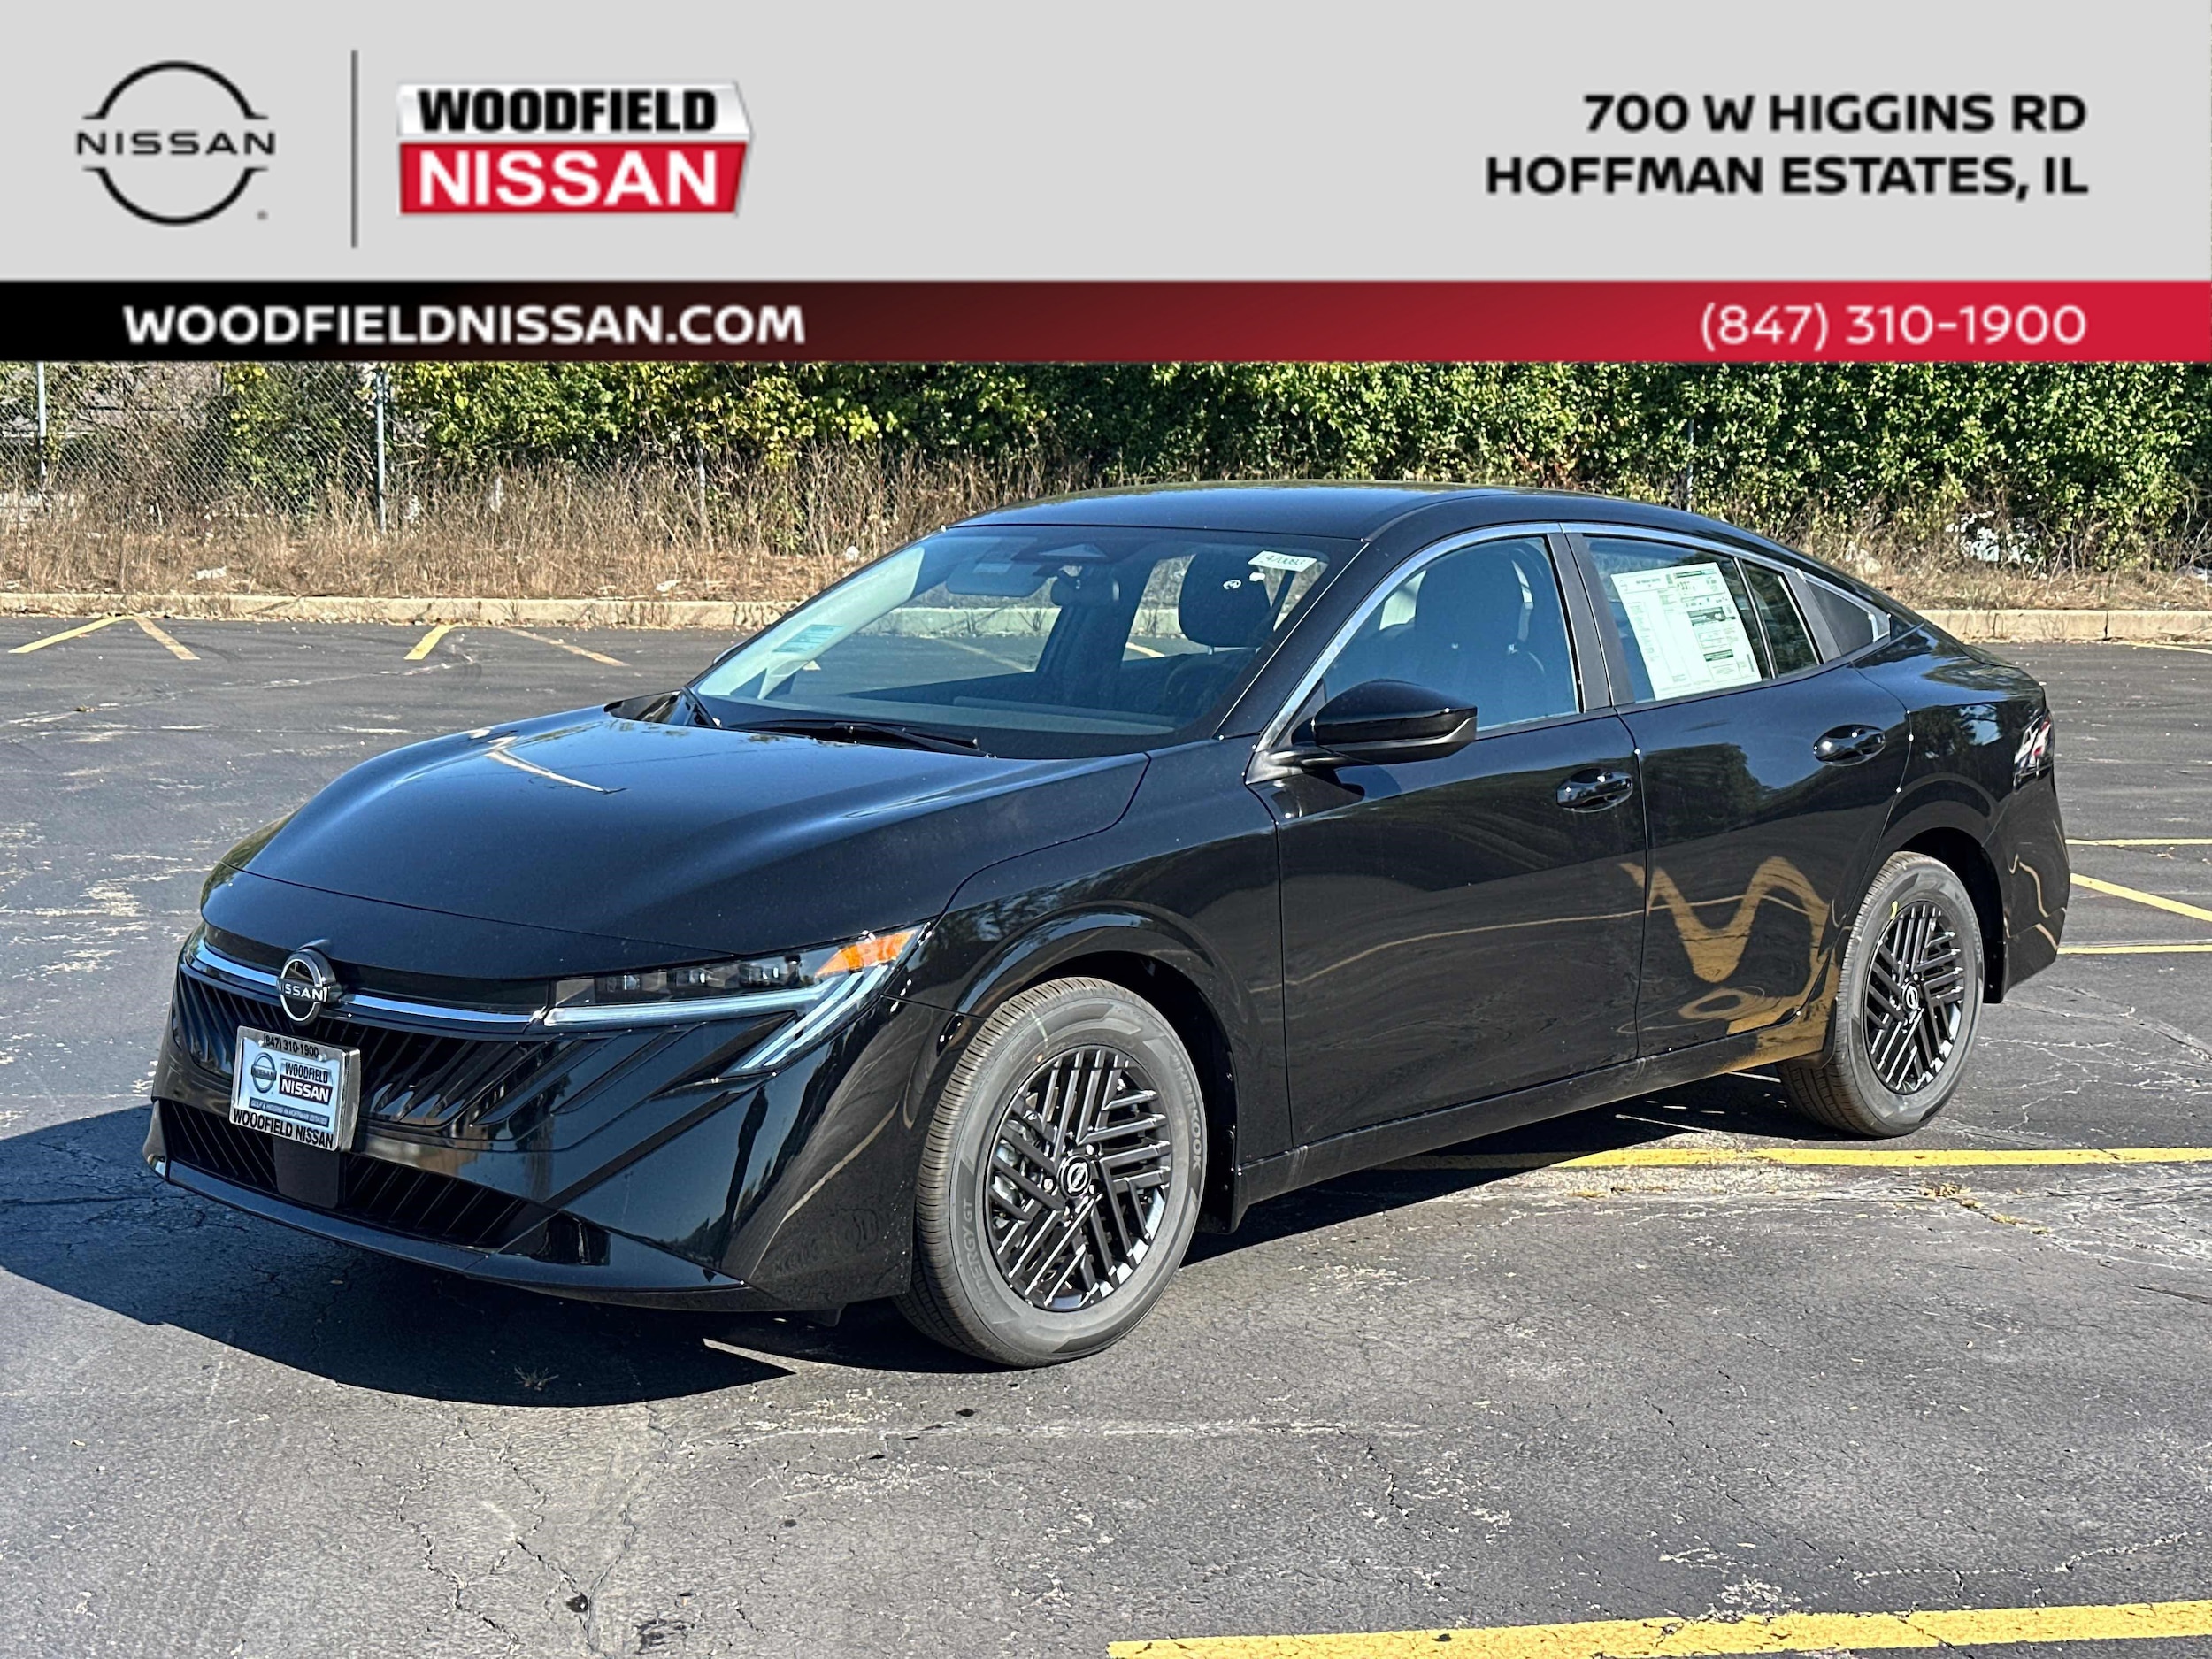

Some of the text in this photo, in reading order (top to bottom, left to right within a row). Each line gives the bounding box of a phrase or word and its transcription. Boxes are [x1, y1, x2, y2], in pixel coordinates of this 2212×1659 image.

[276, 979, 324, 1002] NISSAN
[283, 1039, 319, 1059] 310-1900
[285, 1061, 329, 1085] WOODFIELD
[280, 1078, 329, 1102] NISSAN
[234, 1108, 334, 1149] WOODFIELD NISSAN
